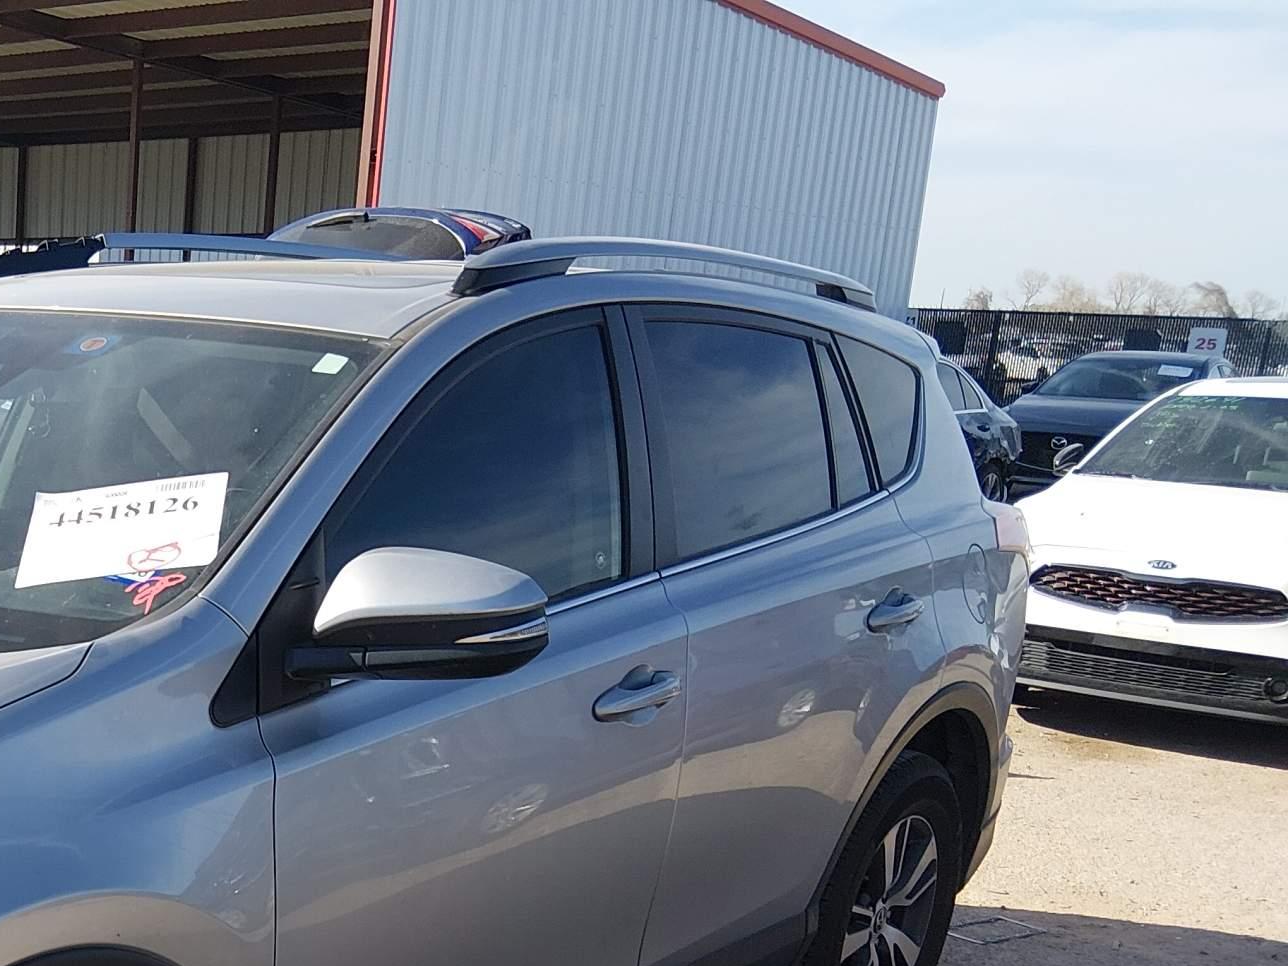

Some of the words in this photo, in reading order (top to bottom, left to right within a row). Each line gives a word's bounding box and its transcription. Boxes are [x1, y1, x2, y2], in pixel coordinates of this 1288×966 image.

[1194, 337, 1217, 351] 25
[49, 496, 199, 527] 44518126
[1150, 560, 1174, 570] KIA
